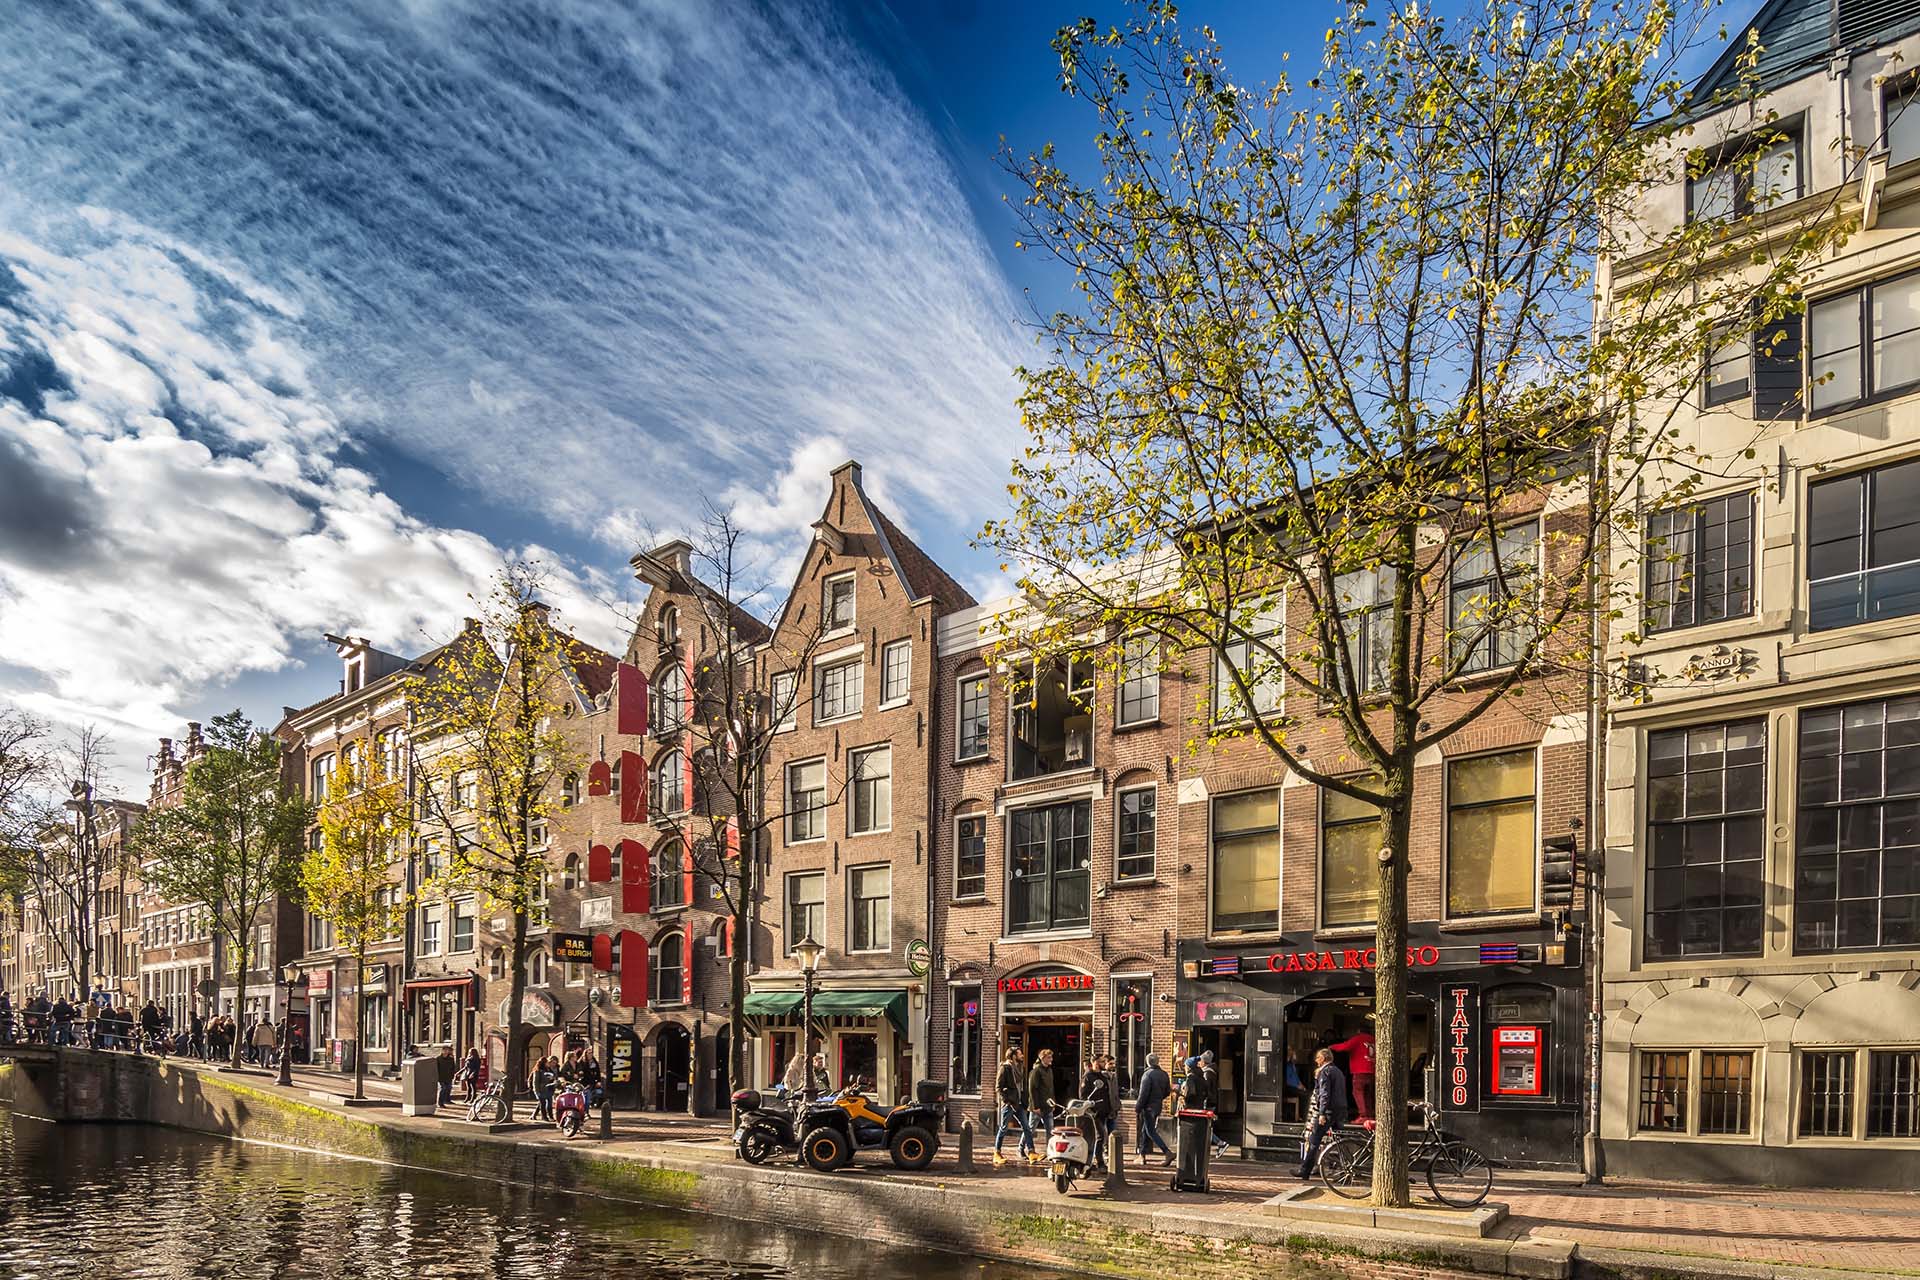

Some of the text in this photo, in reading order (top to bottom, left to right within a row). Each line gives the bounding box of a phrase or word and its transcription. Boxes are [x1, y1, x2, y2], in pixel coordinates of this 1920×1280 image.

[1700, 657, 1731, 669] ANNO
[556, 948, 592, 957] DE BURGH
[565, 939, 585, 949] BAR
[1267, 945, 1440, 972] CASA ROSO
[998, 975, 1094, 993] EXCALIBUR
[1450, 989, 1470, 1105] TATTOO
[612, 1040, 632, 1082] BAR
